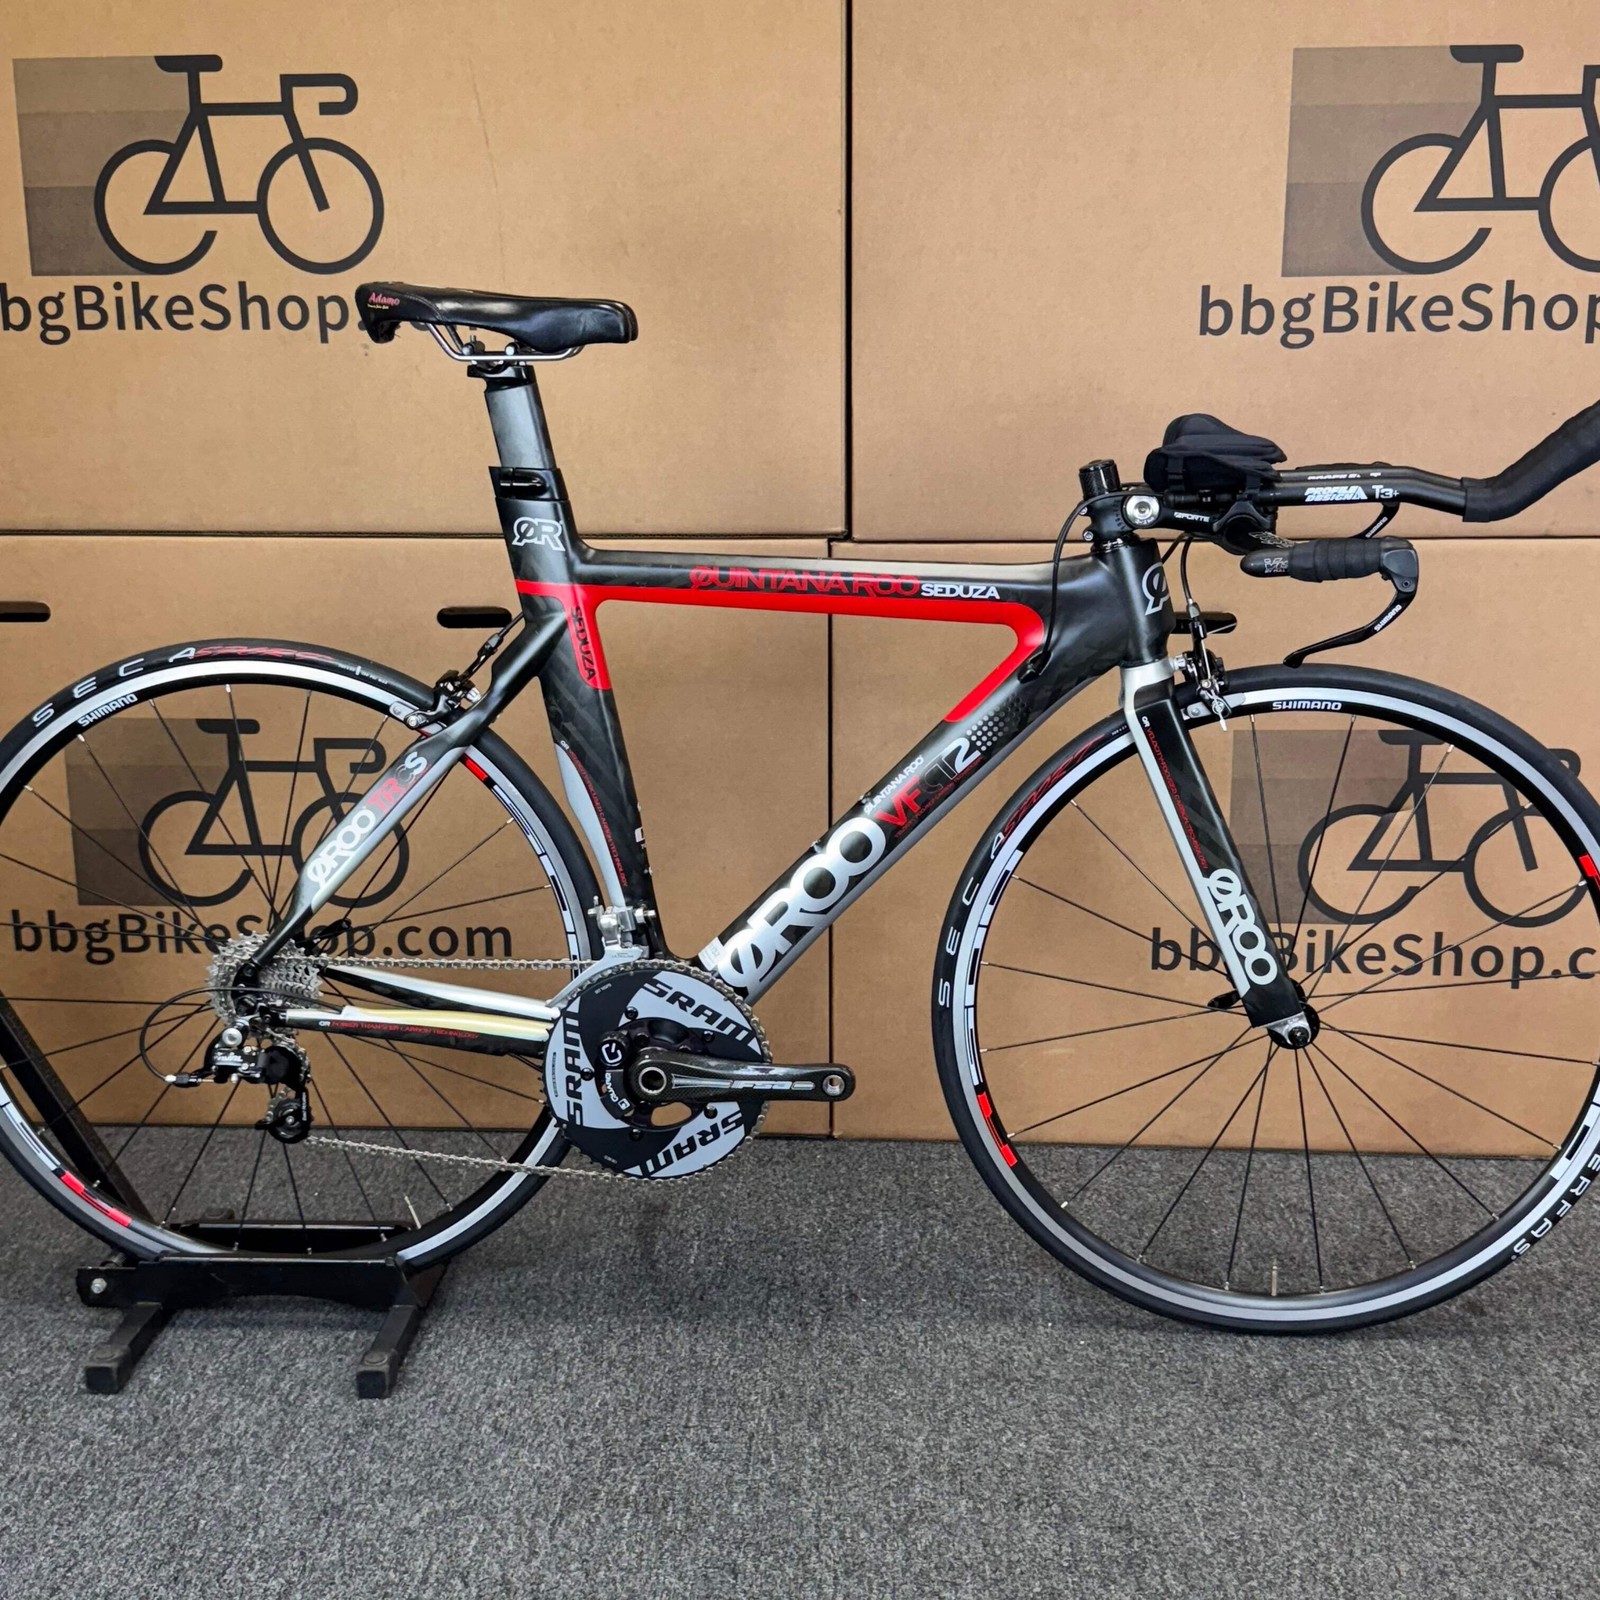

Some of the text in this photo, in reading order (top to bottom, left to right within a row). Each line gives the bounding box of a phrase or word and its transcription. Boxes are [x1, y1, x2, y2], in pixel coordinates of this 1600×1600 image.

[368, 292, 400, 306] Adamo
[921, 583, 1000, 600] SEDUZA
[1373, 604, 1402, 632] SHIMANO
[571, 606, 597, 681] SEDUZA
[32, 647, 196, 728] SECA
[77, 693, 138, 727] SHIMANO
[1272, 700, 1342, 712] SHIMANO
[938, 831, 1005, 1009] SECA
[643, 980, 752, 1042] SRAM
[563, 1009, 585, 1126] SRAM
[648, 1107, 744, 1176] SRAM
